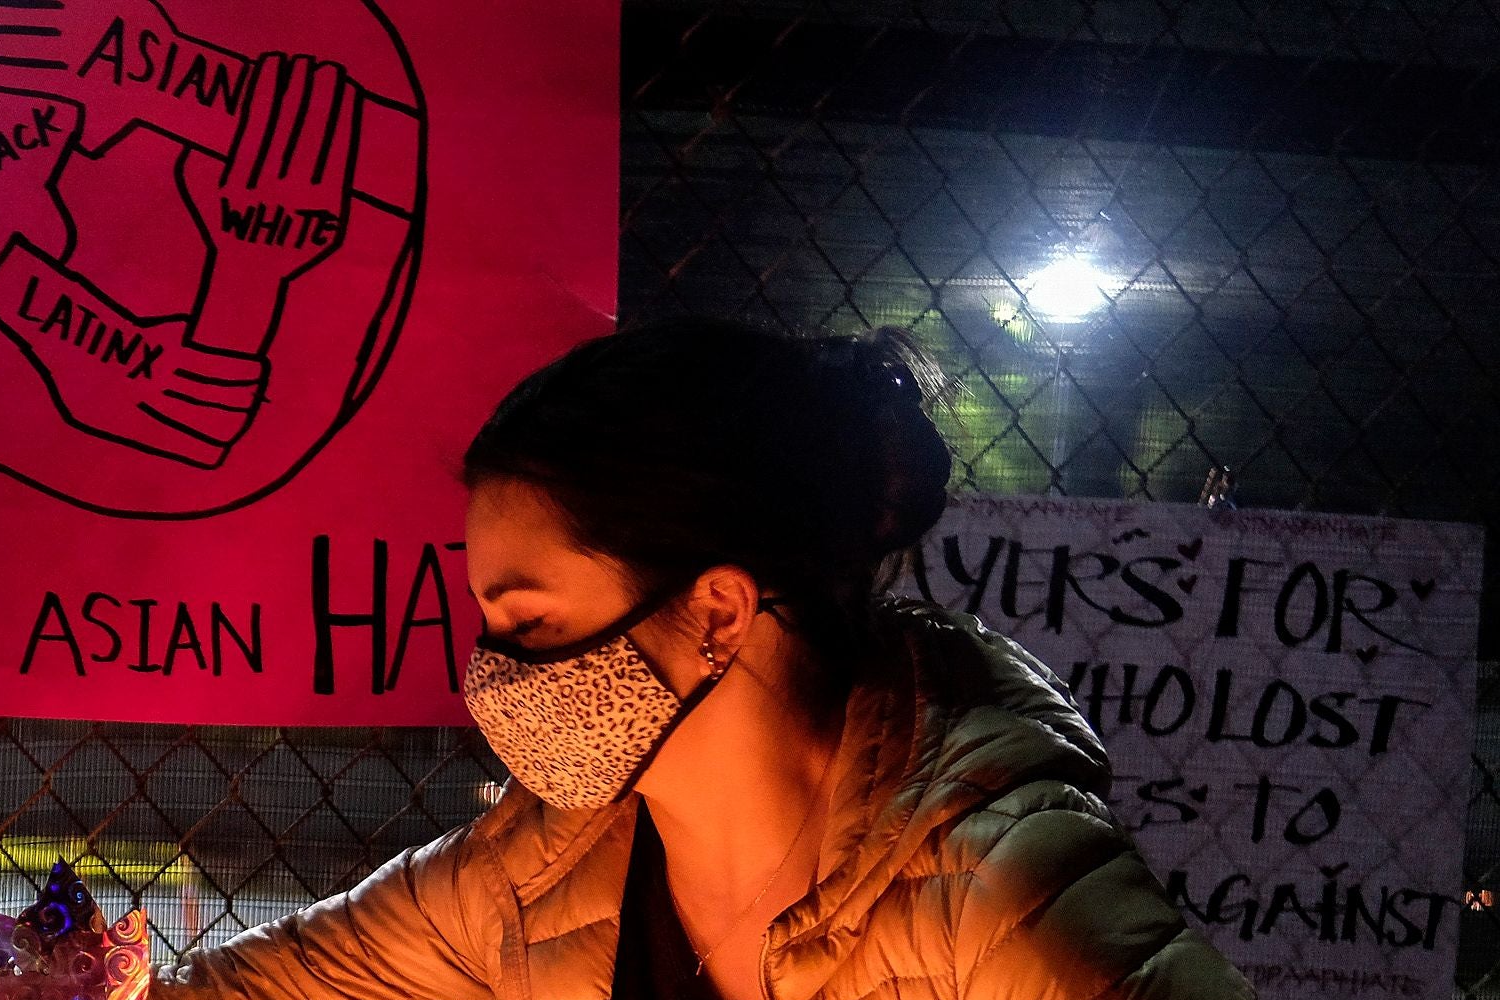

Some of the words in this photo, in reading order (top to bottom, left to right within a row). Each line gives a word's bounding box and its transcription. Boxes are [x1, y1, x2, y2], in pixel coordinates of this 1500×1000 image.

[76, 15, 249, 116] ASIAN
[219, 196, 341, 249] WHITE
[17, 275, 164, 380] LATINX
[20, 592, 262, 678] ASIAN
[311, 534, 467, 695] HA
[1215, 557, 1438, 657] FOR
[1205, 668, 1432, 755] LOST
[1233, 775, 1341, 845] TO
[1167, 862, 1463, 950] AGAINST
